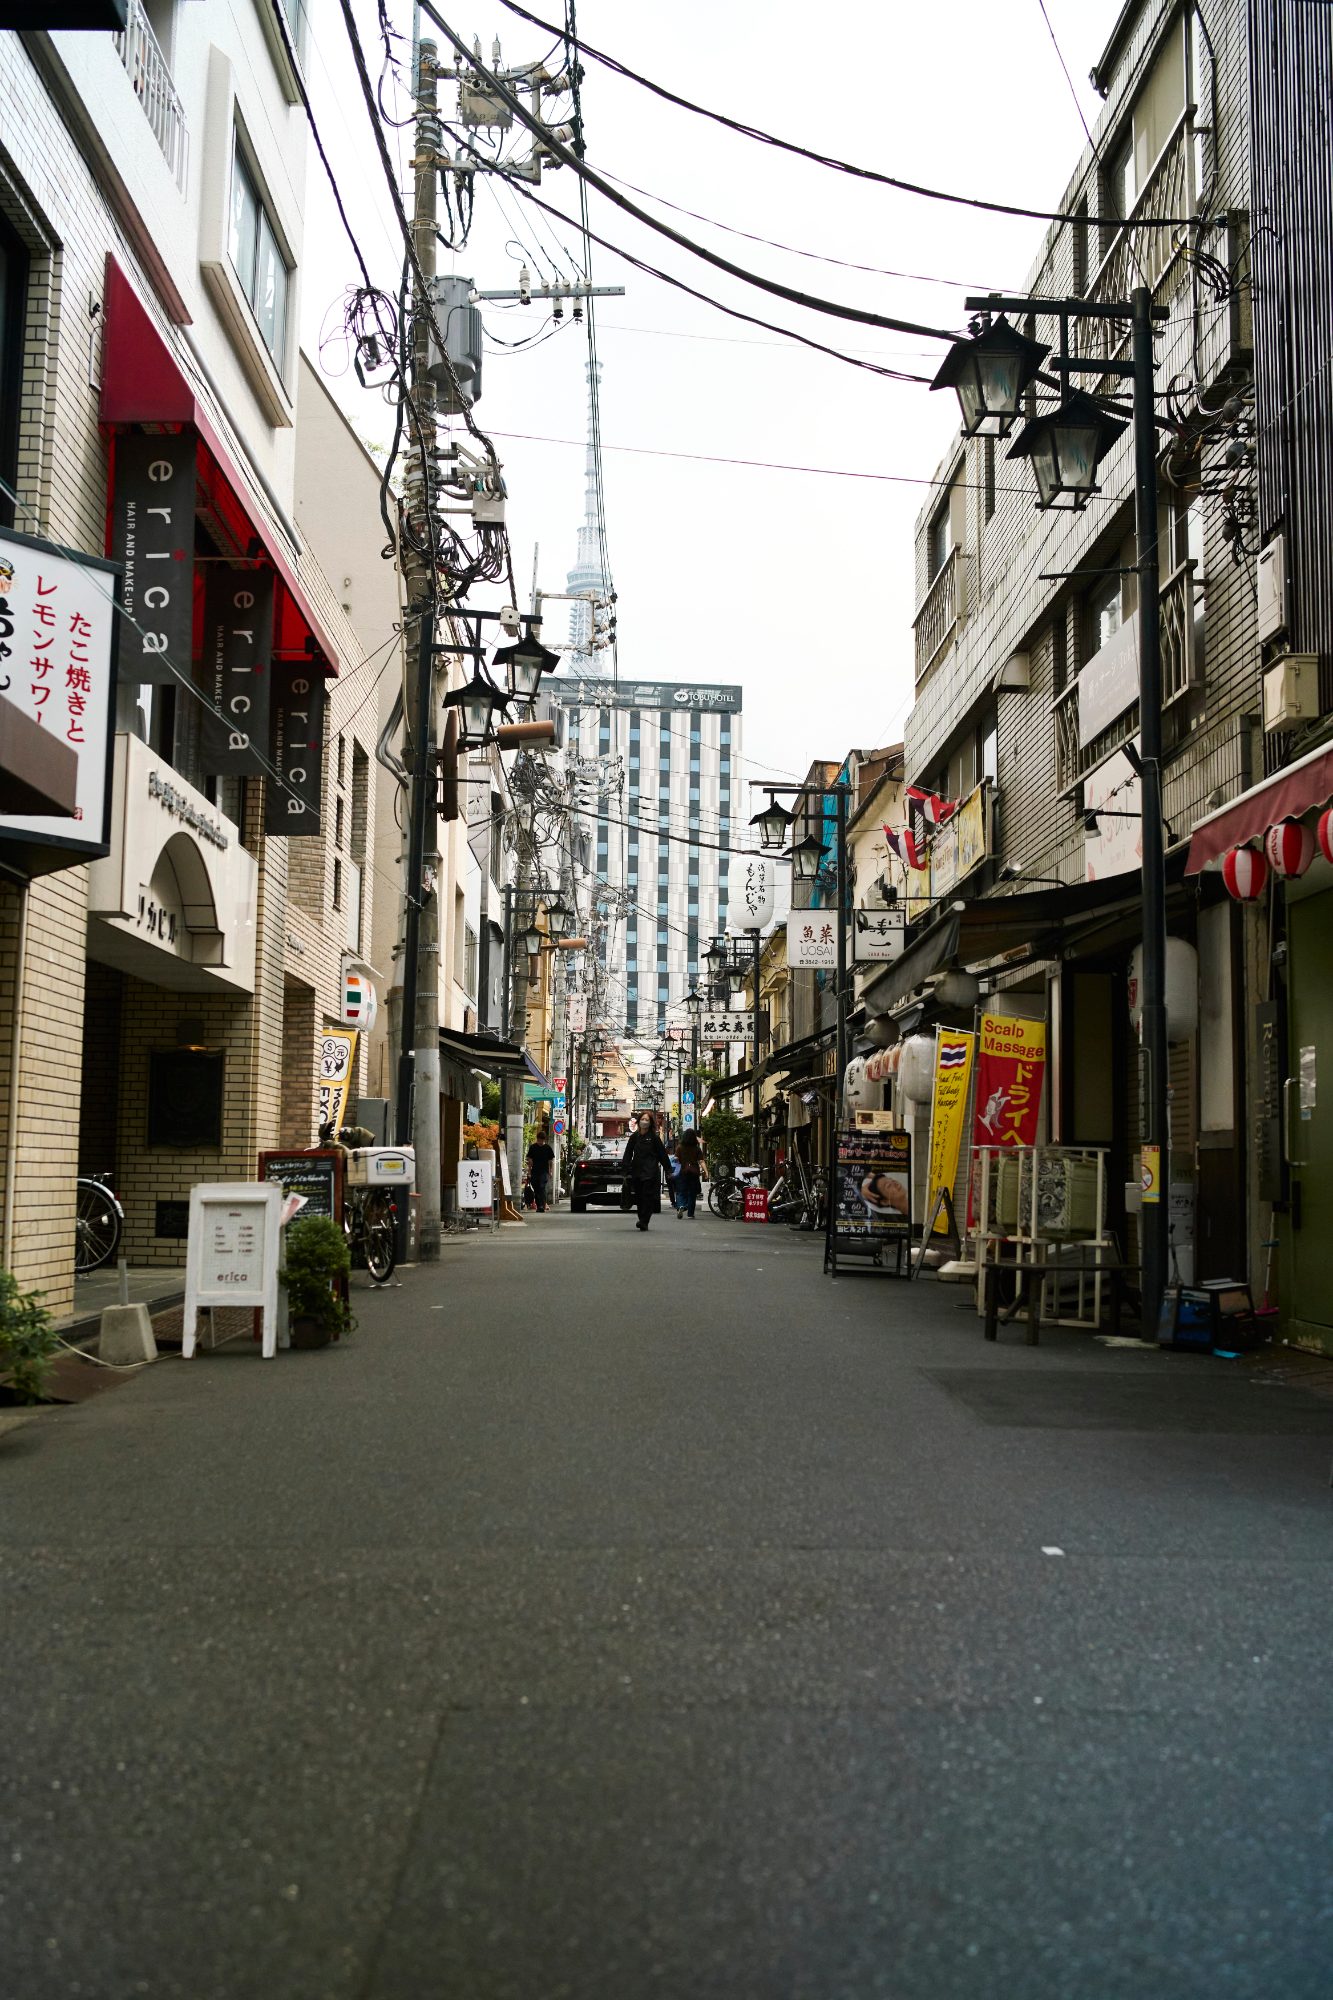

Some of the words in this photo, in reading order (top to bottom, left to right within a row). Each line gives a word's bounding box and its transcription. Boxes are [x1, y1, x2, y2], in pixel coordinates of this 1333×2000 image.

[126, 501, 136, 530] HAIR
[125, 533, 135, 557] AND
[143, 460, 182, 654] erica
[215, 650, 224, 671] AND
[229, 590, 260, 751] erica
[65, 612, 92, 743] たこ焼きと
[711, 694, 735, 702] HOTEL
[288, 678, 316, 814] erica
[799, 924, 835, 945] 魚菜
[800, 946, 833, 956] UOSAI
[984, 1019, 1024, 1038] Scalp
[983, 1036, 1044, 1058] Massage
[468, 1169, 480, 1200] 加とう
[217, 1271, 248, 1282] erica
